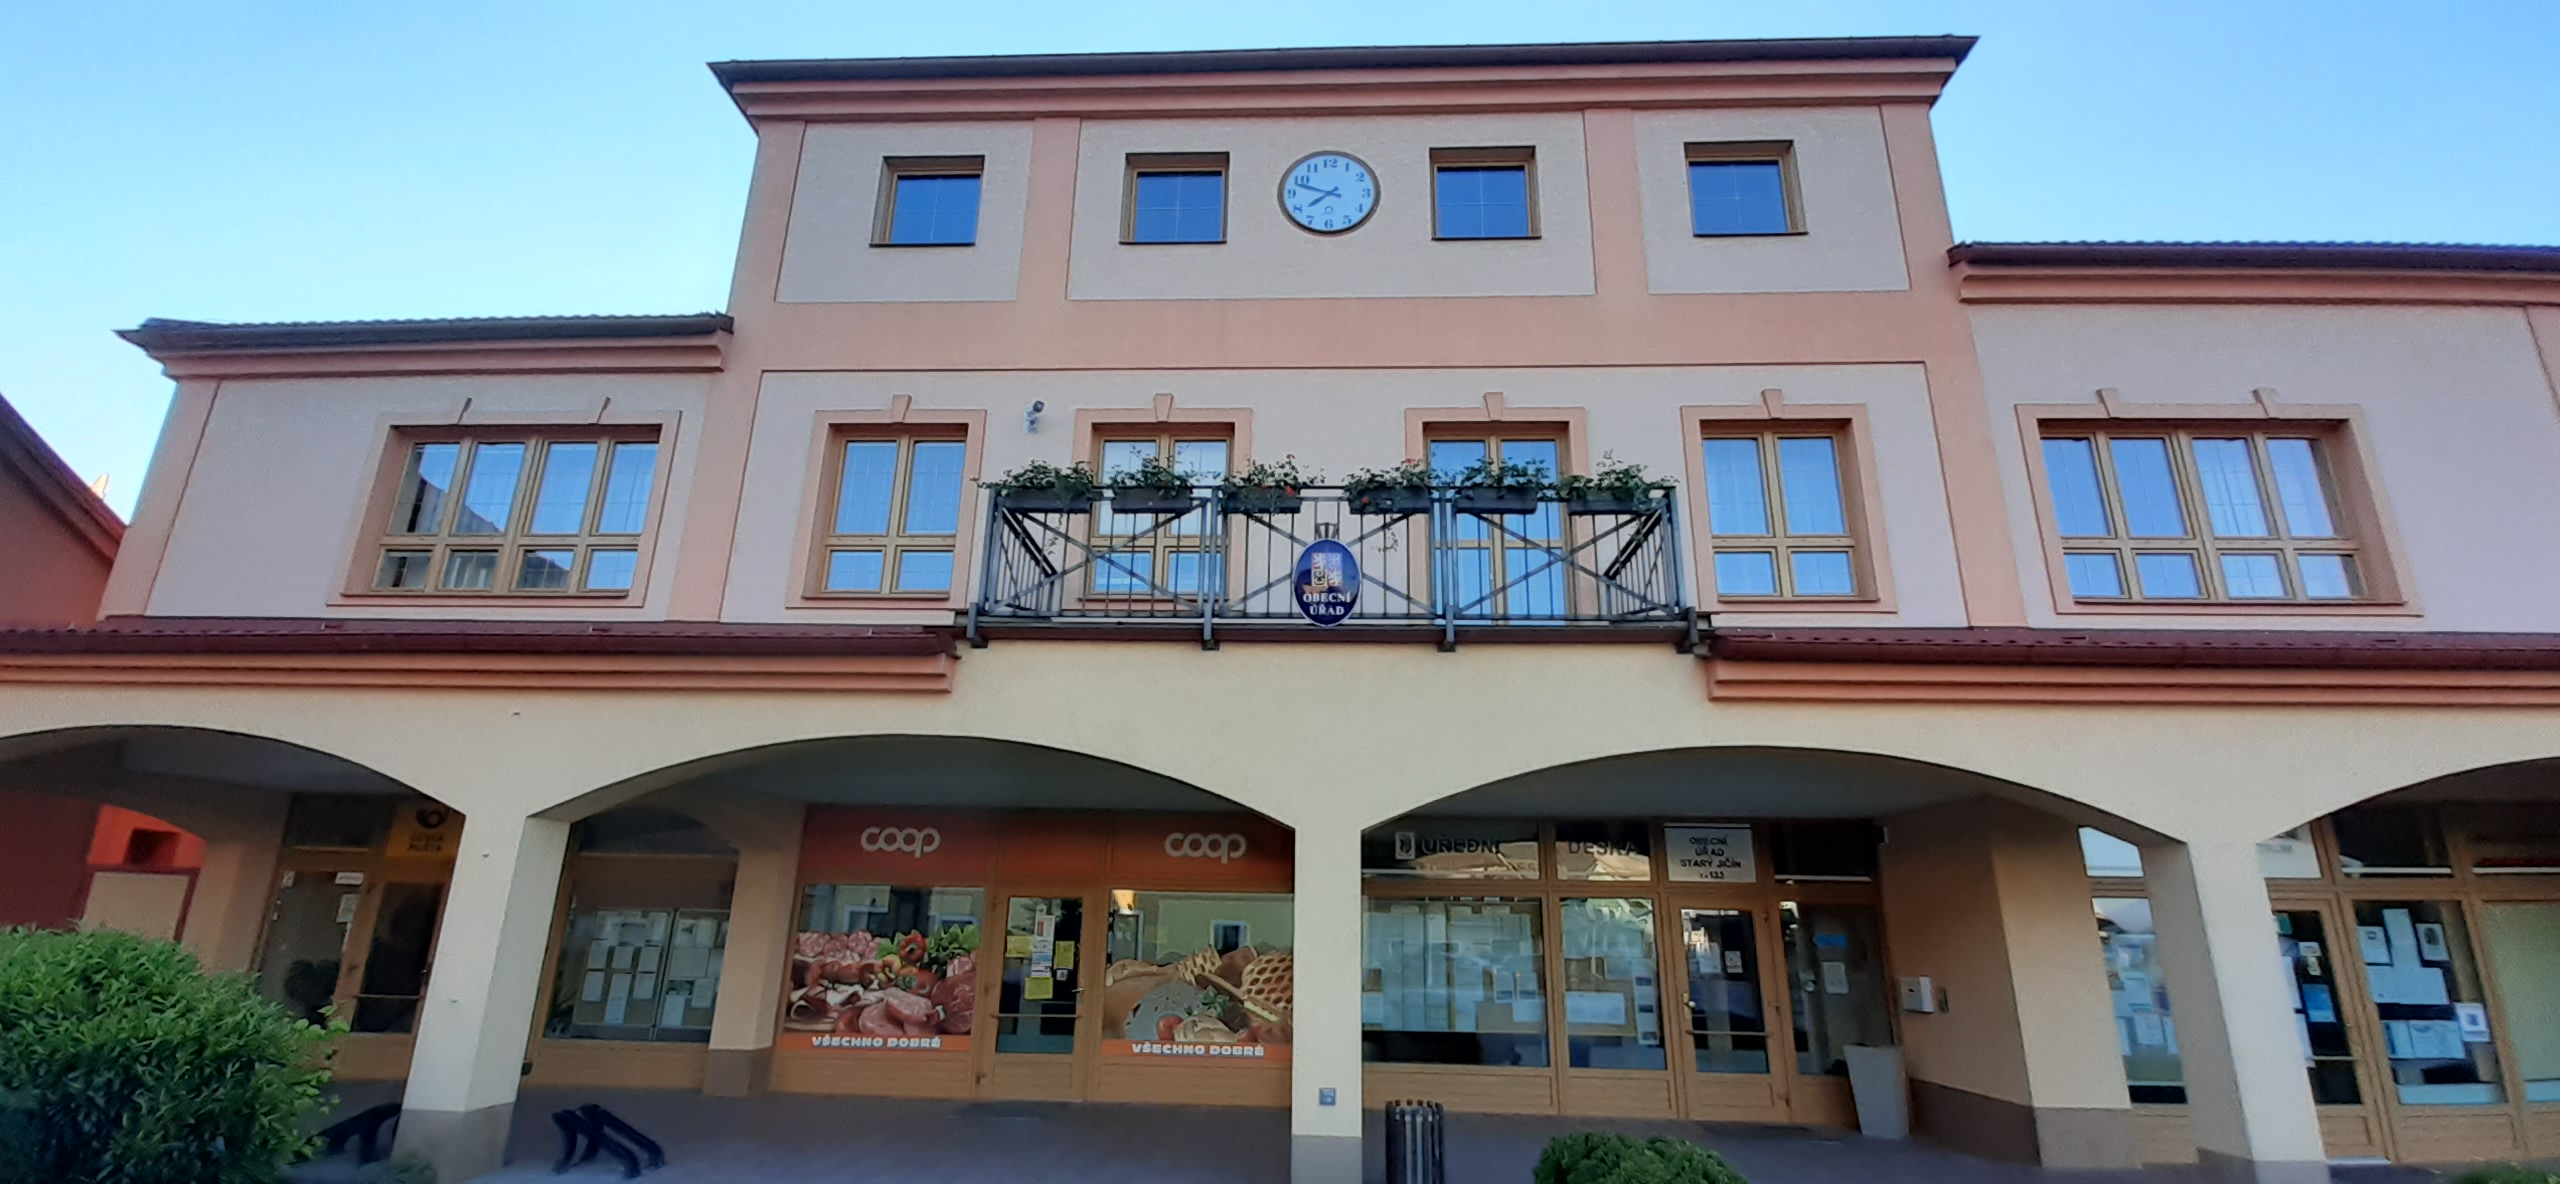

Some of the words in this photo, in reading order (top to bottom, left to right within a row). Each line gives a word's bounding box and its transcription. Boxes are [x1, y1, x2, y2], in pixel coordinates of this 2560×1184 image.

[1306, 163, 1318, 173] 11
[1323, 158, 1338, 169] 12
[1344, 162, 1350, 172] 1
[1294, 175, 1311, 186] 10
[1355, 172, 1365, 182] 2
[1287, 188, 1297, 199] 9
[1362, 188, 1371, 198] 3
[1293, 204, 1302, 214] 8
[1354, 203, 1363, 213] 4
[1306, 215, 1315, 225] 7
[1323, 219, 1333, 229] 6
[1343, 215, 1352, 225] 5
[1303, 591, 1351, 603] OBECNÍ
[1309, 603, 1345, 616] ÚŘAD
[860, 826, 941, 858] coop
[1568, 839, 1638, 856] DESKA
[1164, 832, 1246, 864] coop
[812, 1034, 884, 1048] VŠECHNO
[887, 1036, 942, 1049] DOBRÉ
[1132, 1041, 1206, 1055] VŠECHNO
[1209, 1044, 1265, 1057] DOBRÉ
